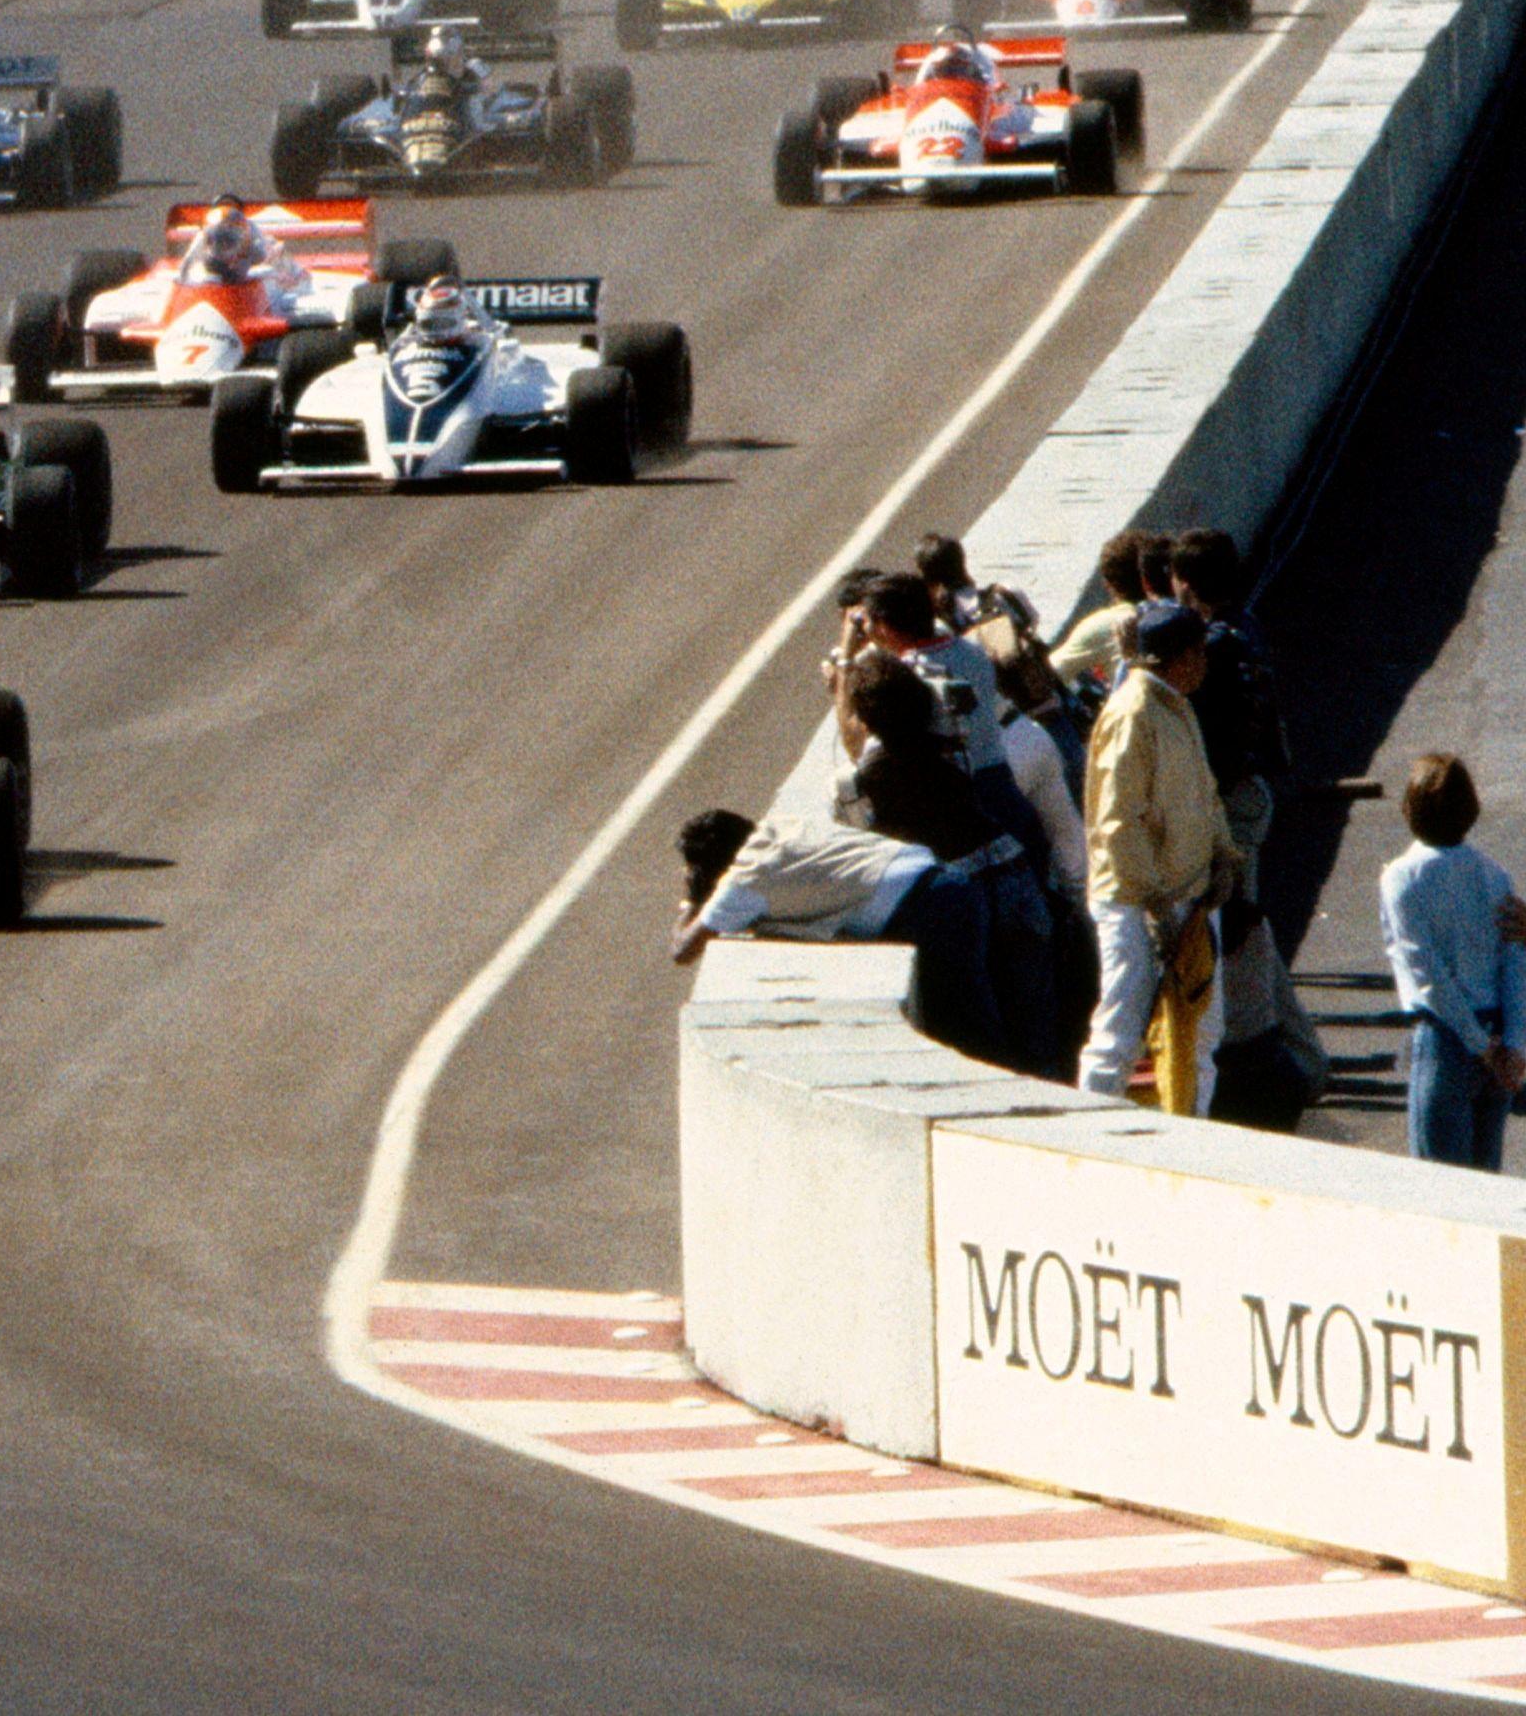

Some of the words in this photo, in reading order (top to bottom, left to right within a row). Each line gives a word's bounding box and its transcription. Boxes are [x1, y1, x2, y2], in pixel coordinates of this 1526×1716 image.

[183, 344, 210, 365] 7
[960, 1238, 1183, 1398] MOËT
[1242, 1290, 1481, 1462] MOËT
